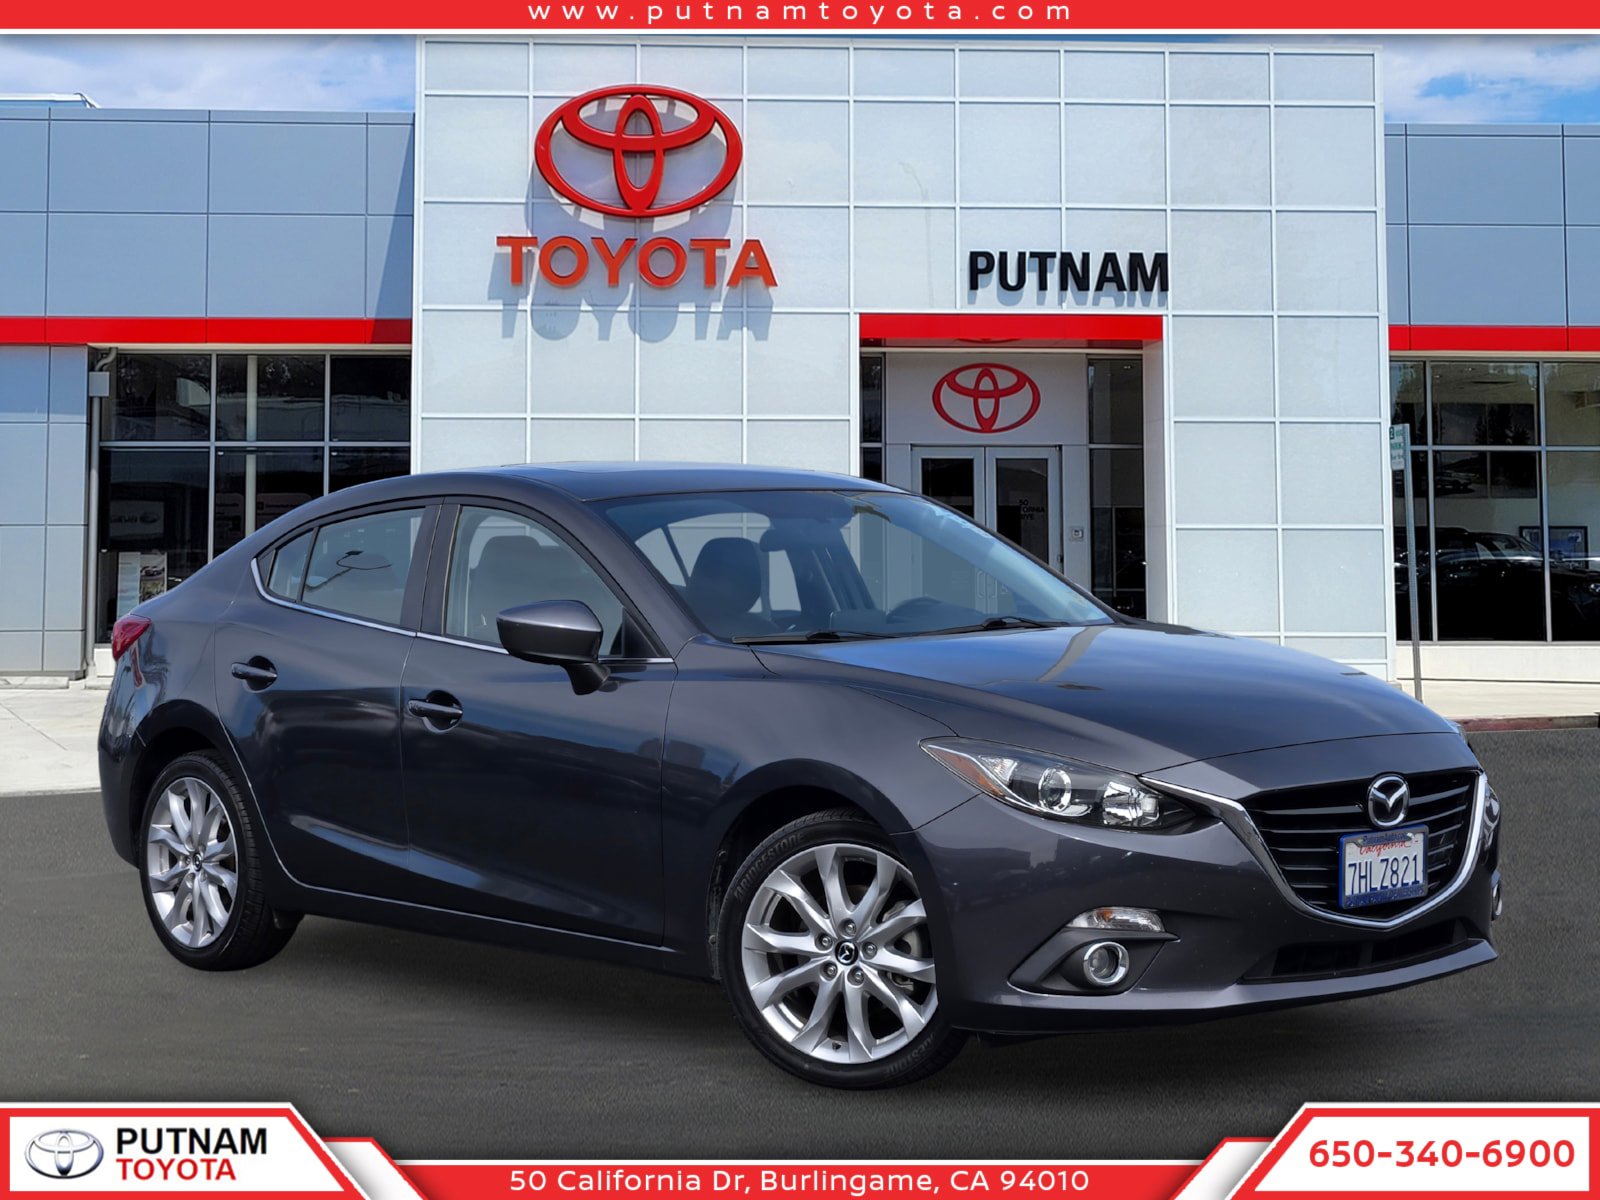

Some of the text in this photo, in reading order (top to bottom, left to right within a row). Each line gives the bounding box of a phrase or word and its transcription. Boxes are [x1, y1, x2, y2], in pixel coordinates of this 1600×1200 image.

[496, 236, 778, 287] TOYOTA
[969, 251, 1169, 292] PUTNAM
[1348, 854, 1420, 895] 7HLZ821
